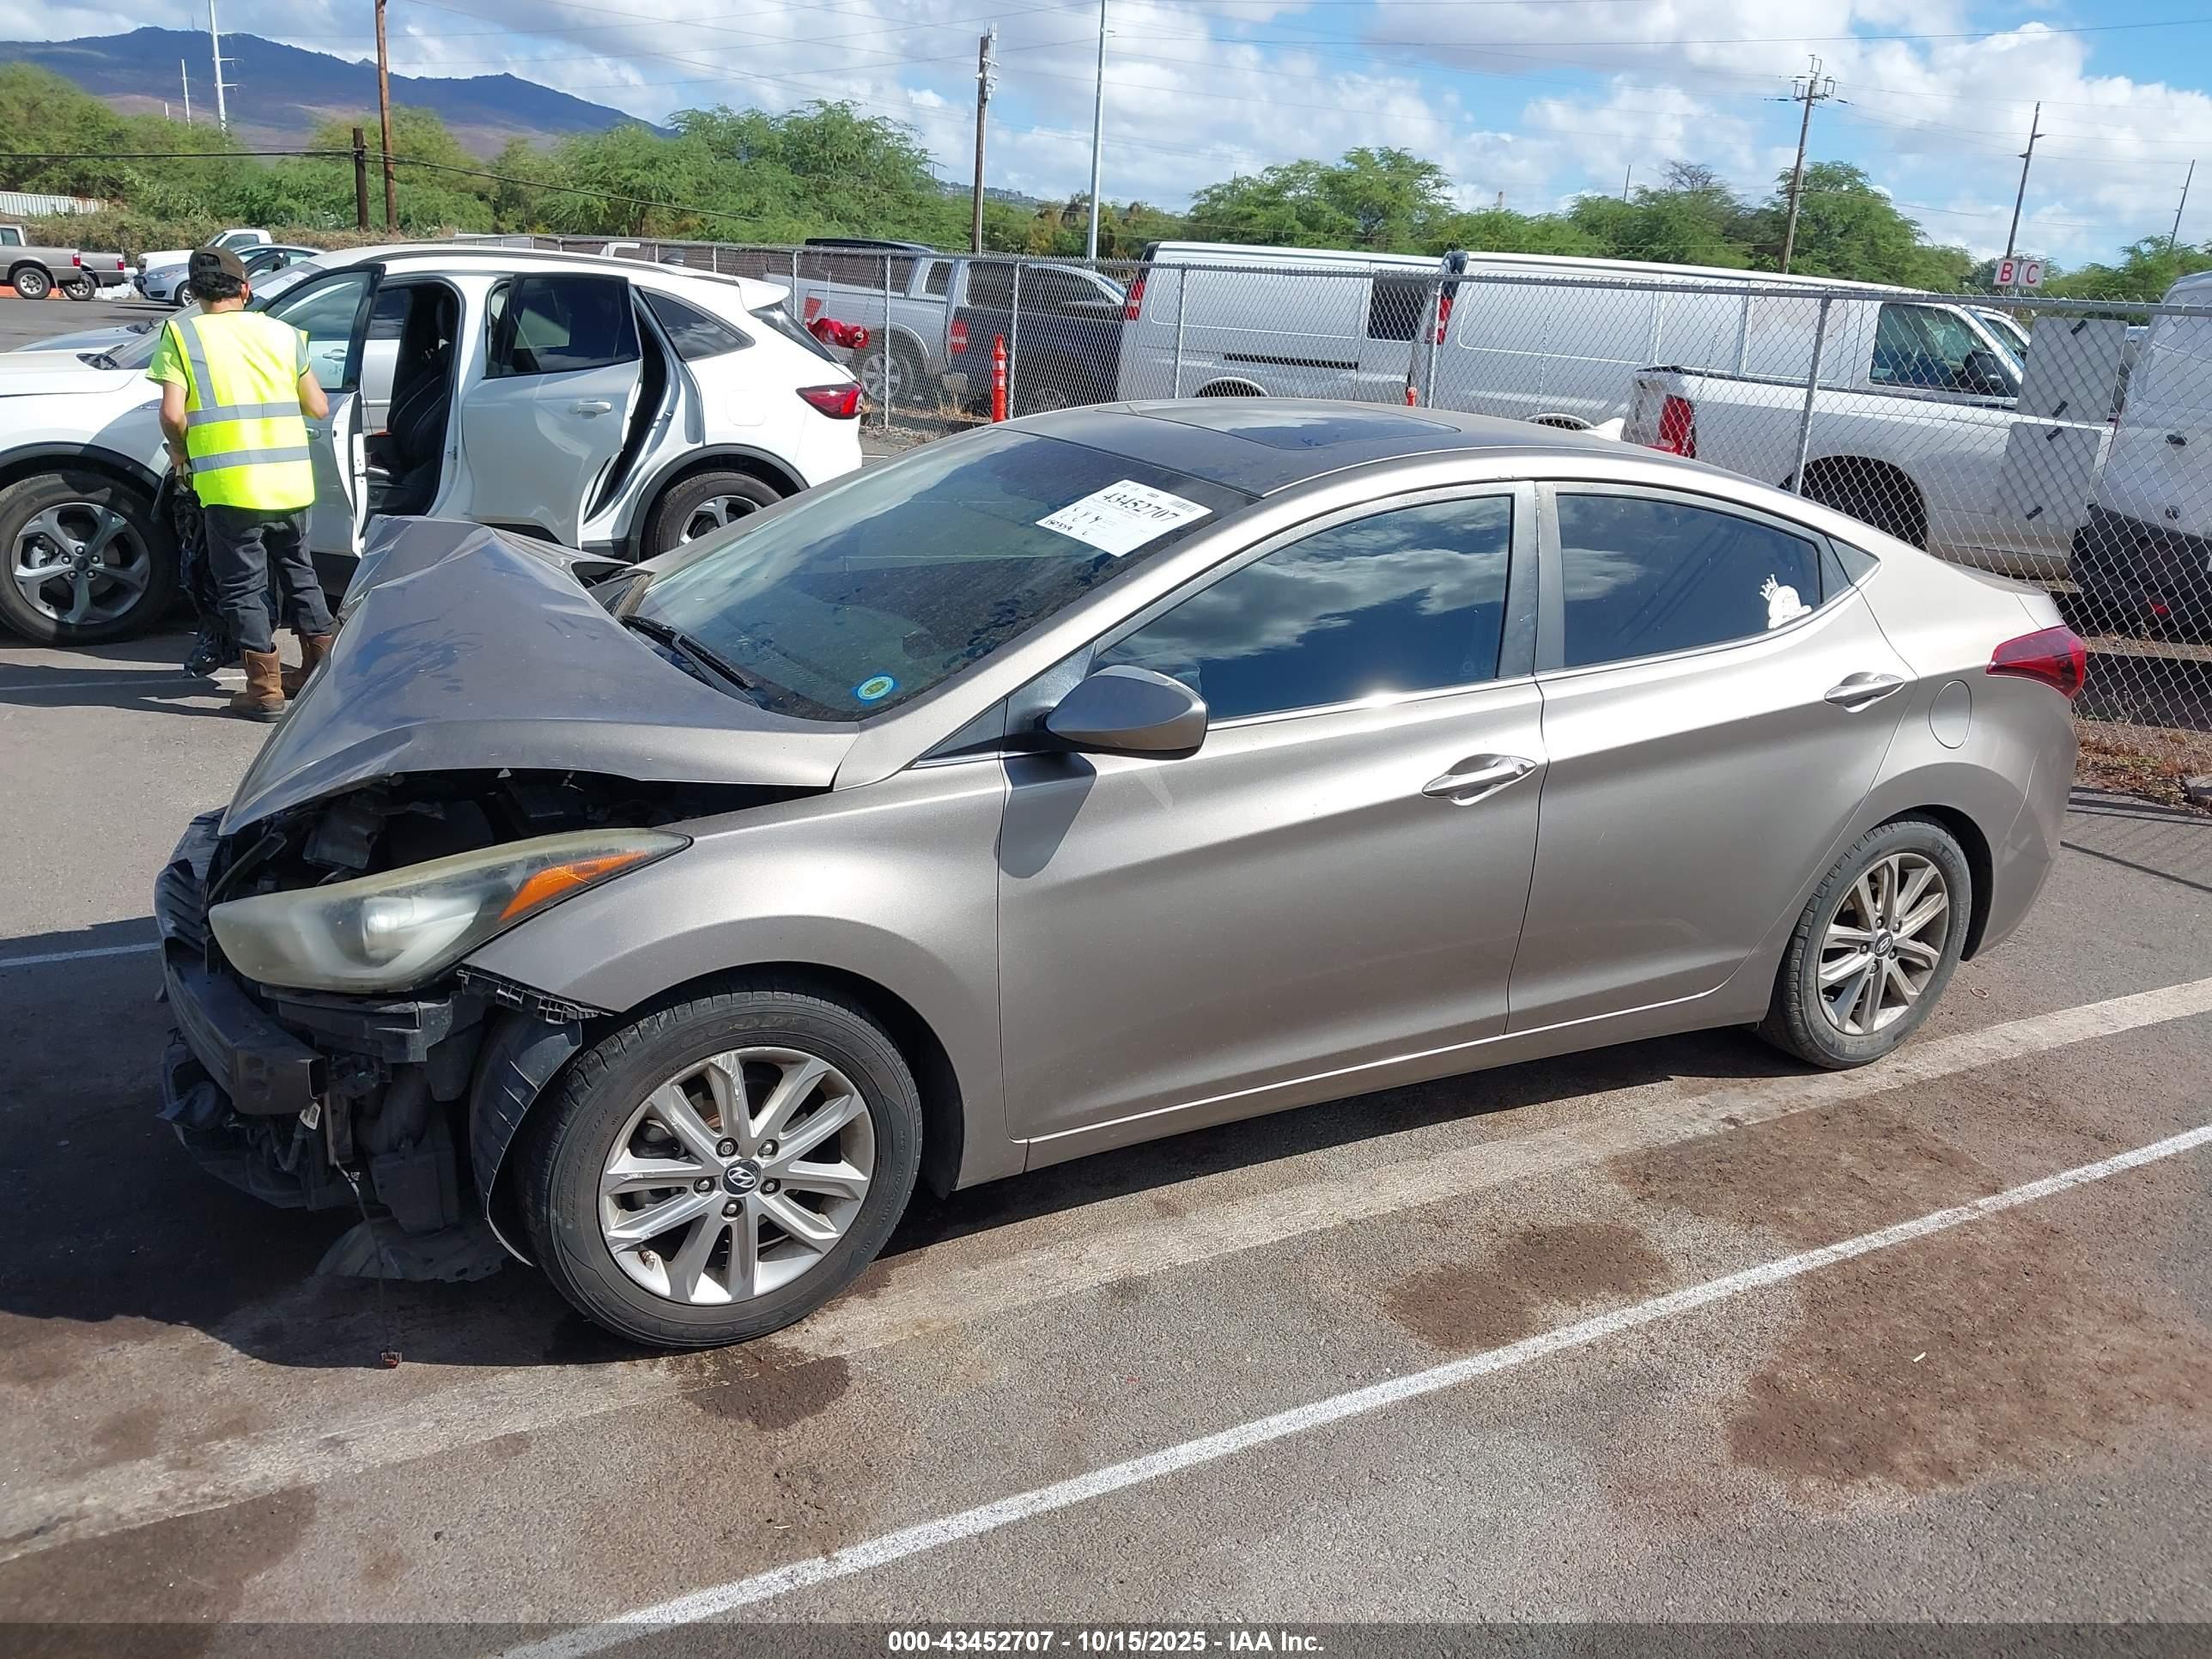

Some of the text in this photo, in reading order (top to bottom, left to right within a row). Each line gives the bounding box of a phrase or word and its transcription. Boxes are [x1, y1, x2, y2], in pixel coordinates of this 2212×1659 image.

[2000, 262, 2039, 283] B C
[1103, 492, 1181, 522] 43452707
